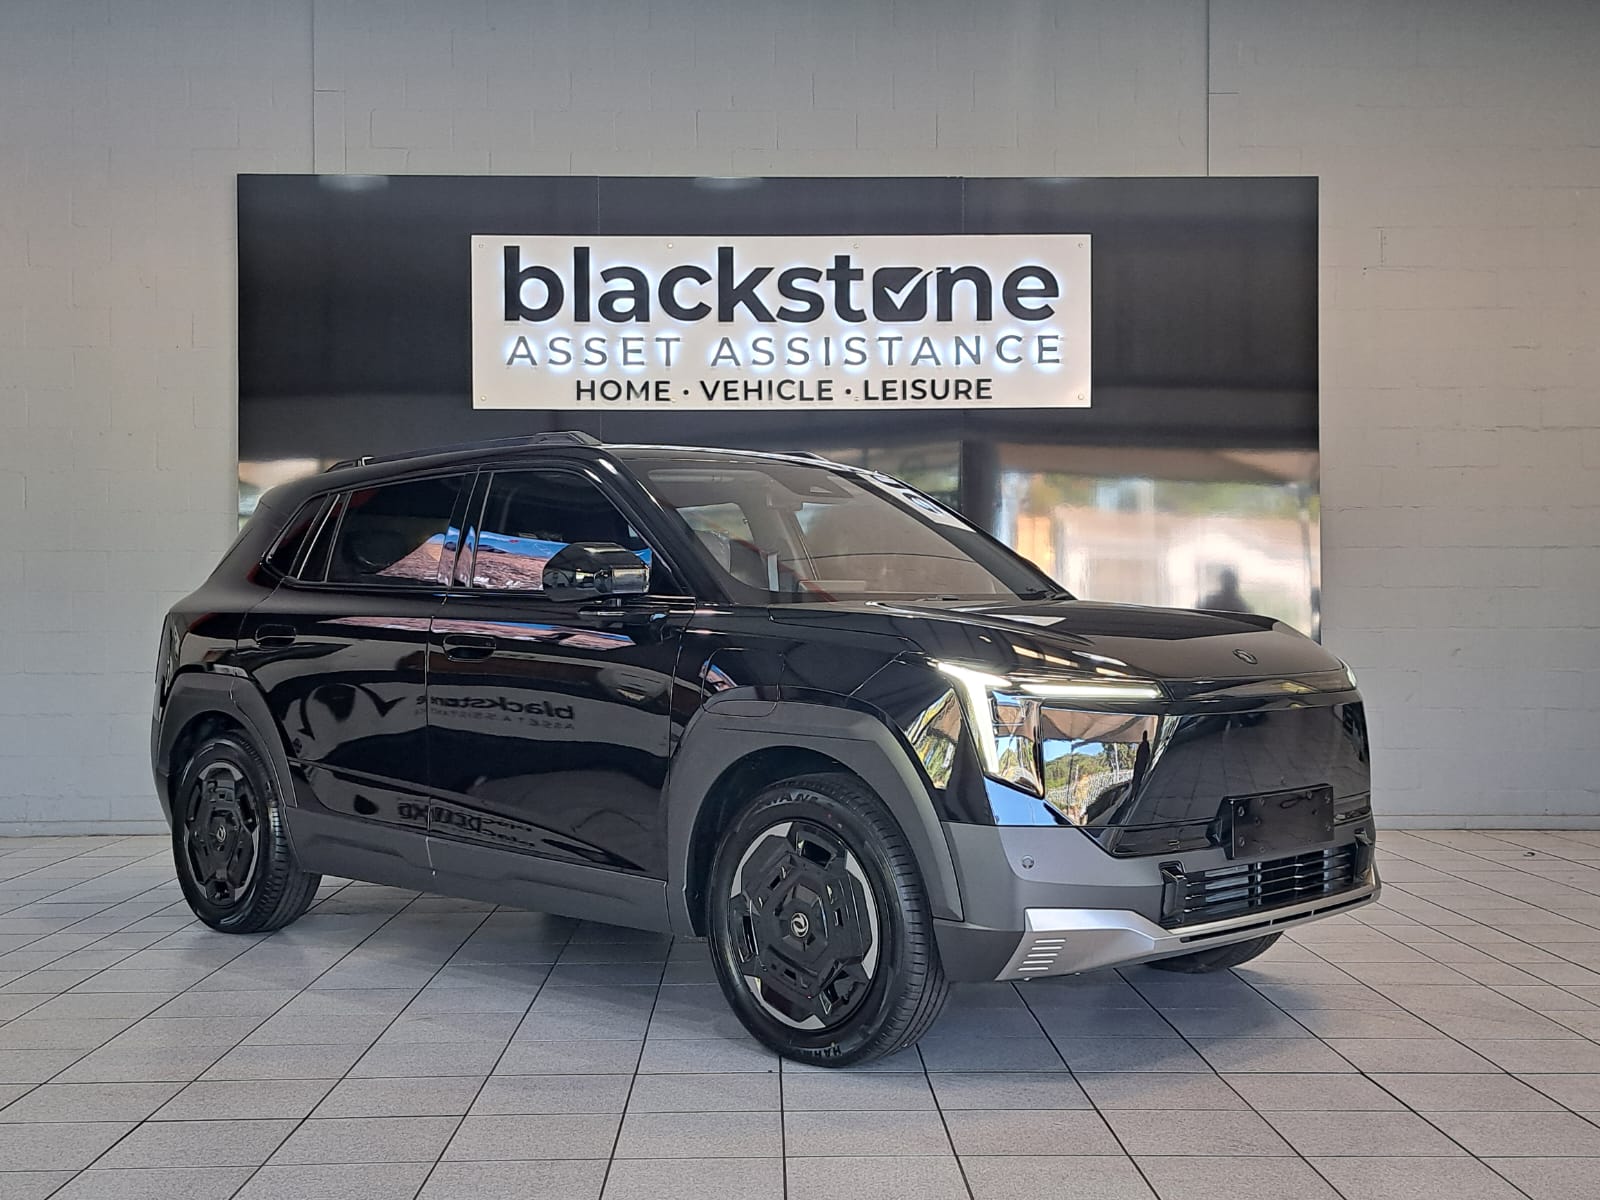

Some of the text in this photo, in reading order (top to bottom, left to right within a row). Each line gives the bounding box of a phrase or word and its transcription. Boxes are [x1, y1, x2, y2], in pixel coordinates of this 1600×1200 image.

[503, 245, 1060, 323] blackstone
[505, 334, 1062, 368] ASSET ASSISTANCE
[576, 378, 993, 402] HOME VEHICLE LEISURE
